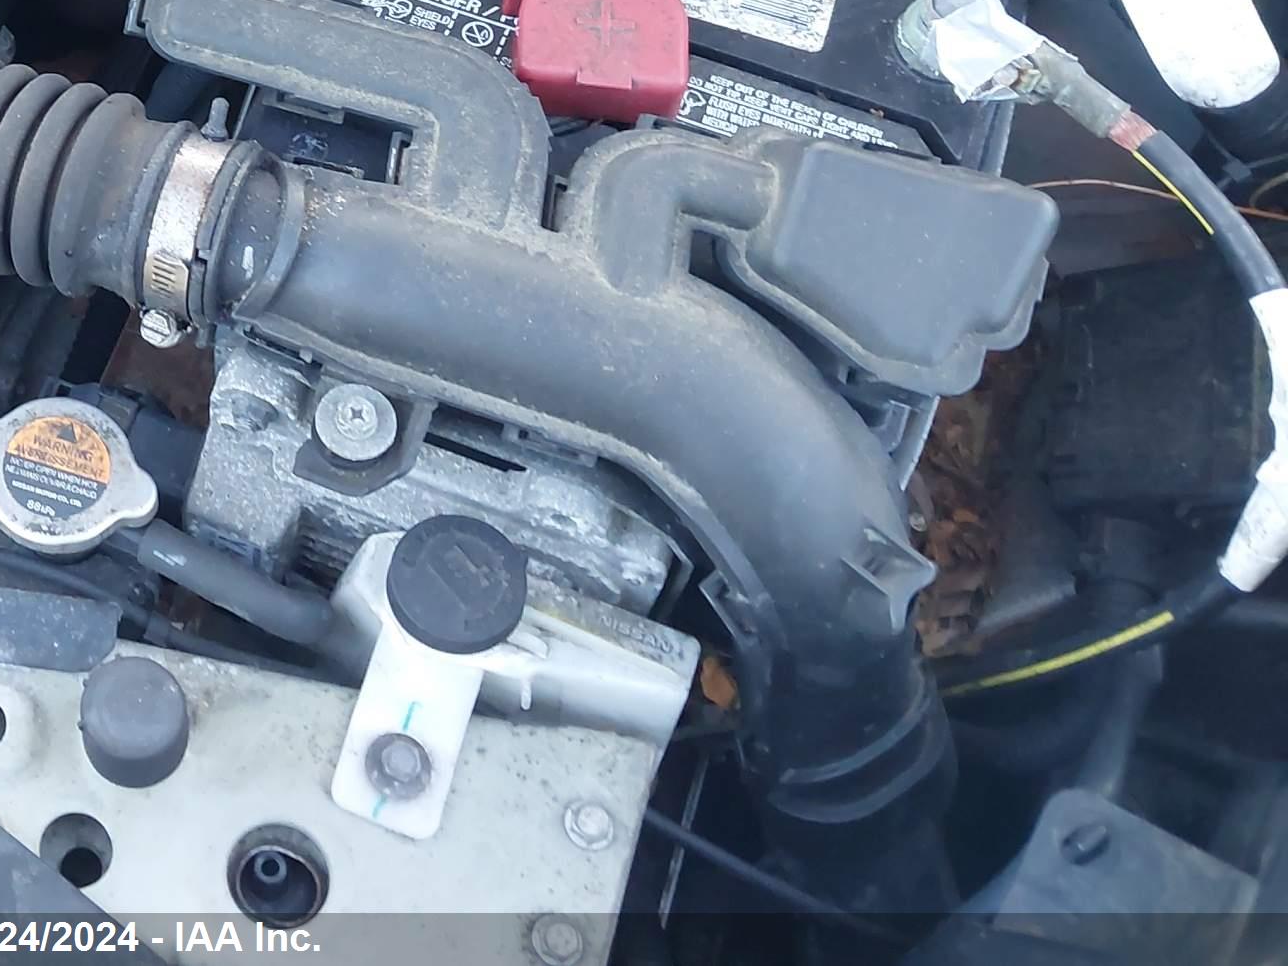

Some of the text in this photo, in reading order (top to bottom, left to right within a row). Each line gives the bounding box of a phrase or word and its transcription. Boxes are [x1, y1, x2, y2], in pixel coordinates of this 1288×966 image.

[408, 14, 436, 31] EYES
[413, 6, 451, 25] SHIELD
[703, 80, 723, 93] NOT
[742, 94, 768, 108] KEEP
[768, 102, 793, 116] VENT
[849, 129, 870, 142] AND
[707, 95, 738, 113] FLUSH
[736, 105, 762, 121] EYES
[709, 74, 734, 88] KEEP
[733, 82, 755, 95] OUT
[754, 88, 770, 100] OF
[769, 94, 790, 107] THE
[821, 111, 837, 122] OF
[704, 105, 729, 120] WITH
[33, 435, 94, 461] WARNING
